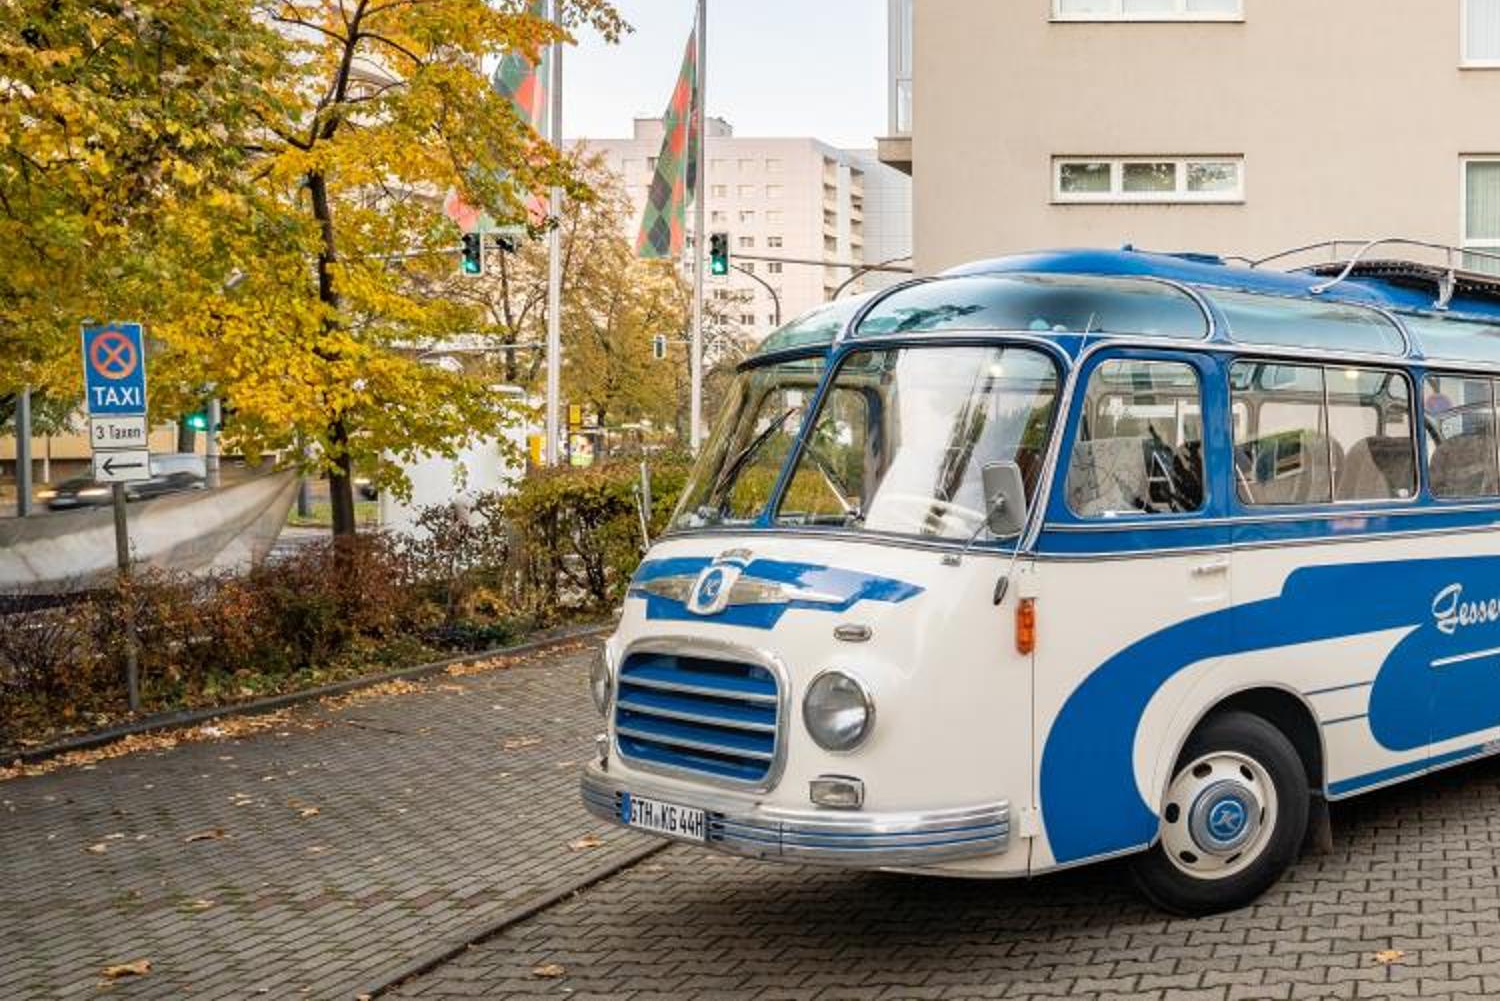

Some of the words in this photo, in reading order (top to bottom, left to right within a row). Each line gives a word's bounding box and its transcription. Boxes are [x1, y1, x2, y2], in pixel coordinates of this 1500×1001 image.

[92, 385, 142, 407] TAXI
[95, 426, 105, 440] 3
[108, 424, 141, 440] Taxen
[679, 808, 704, 838] 44H
